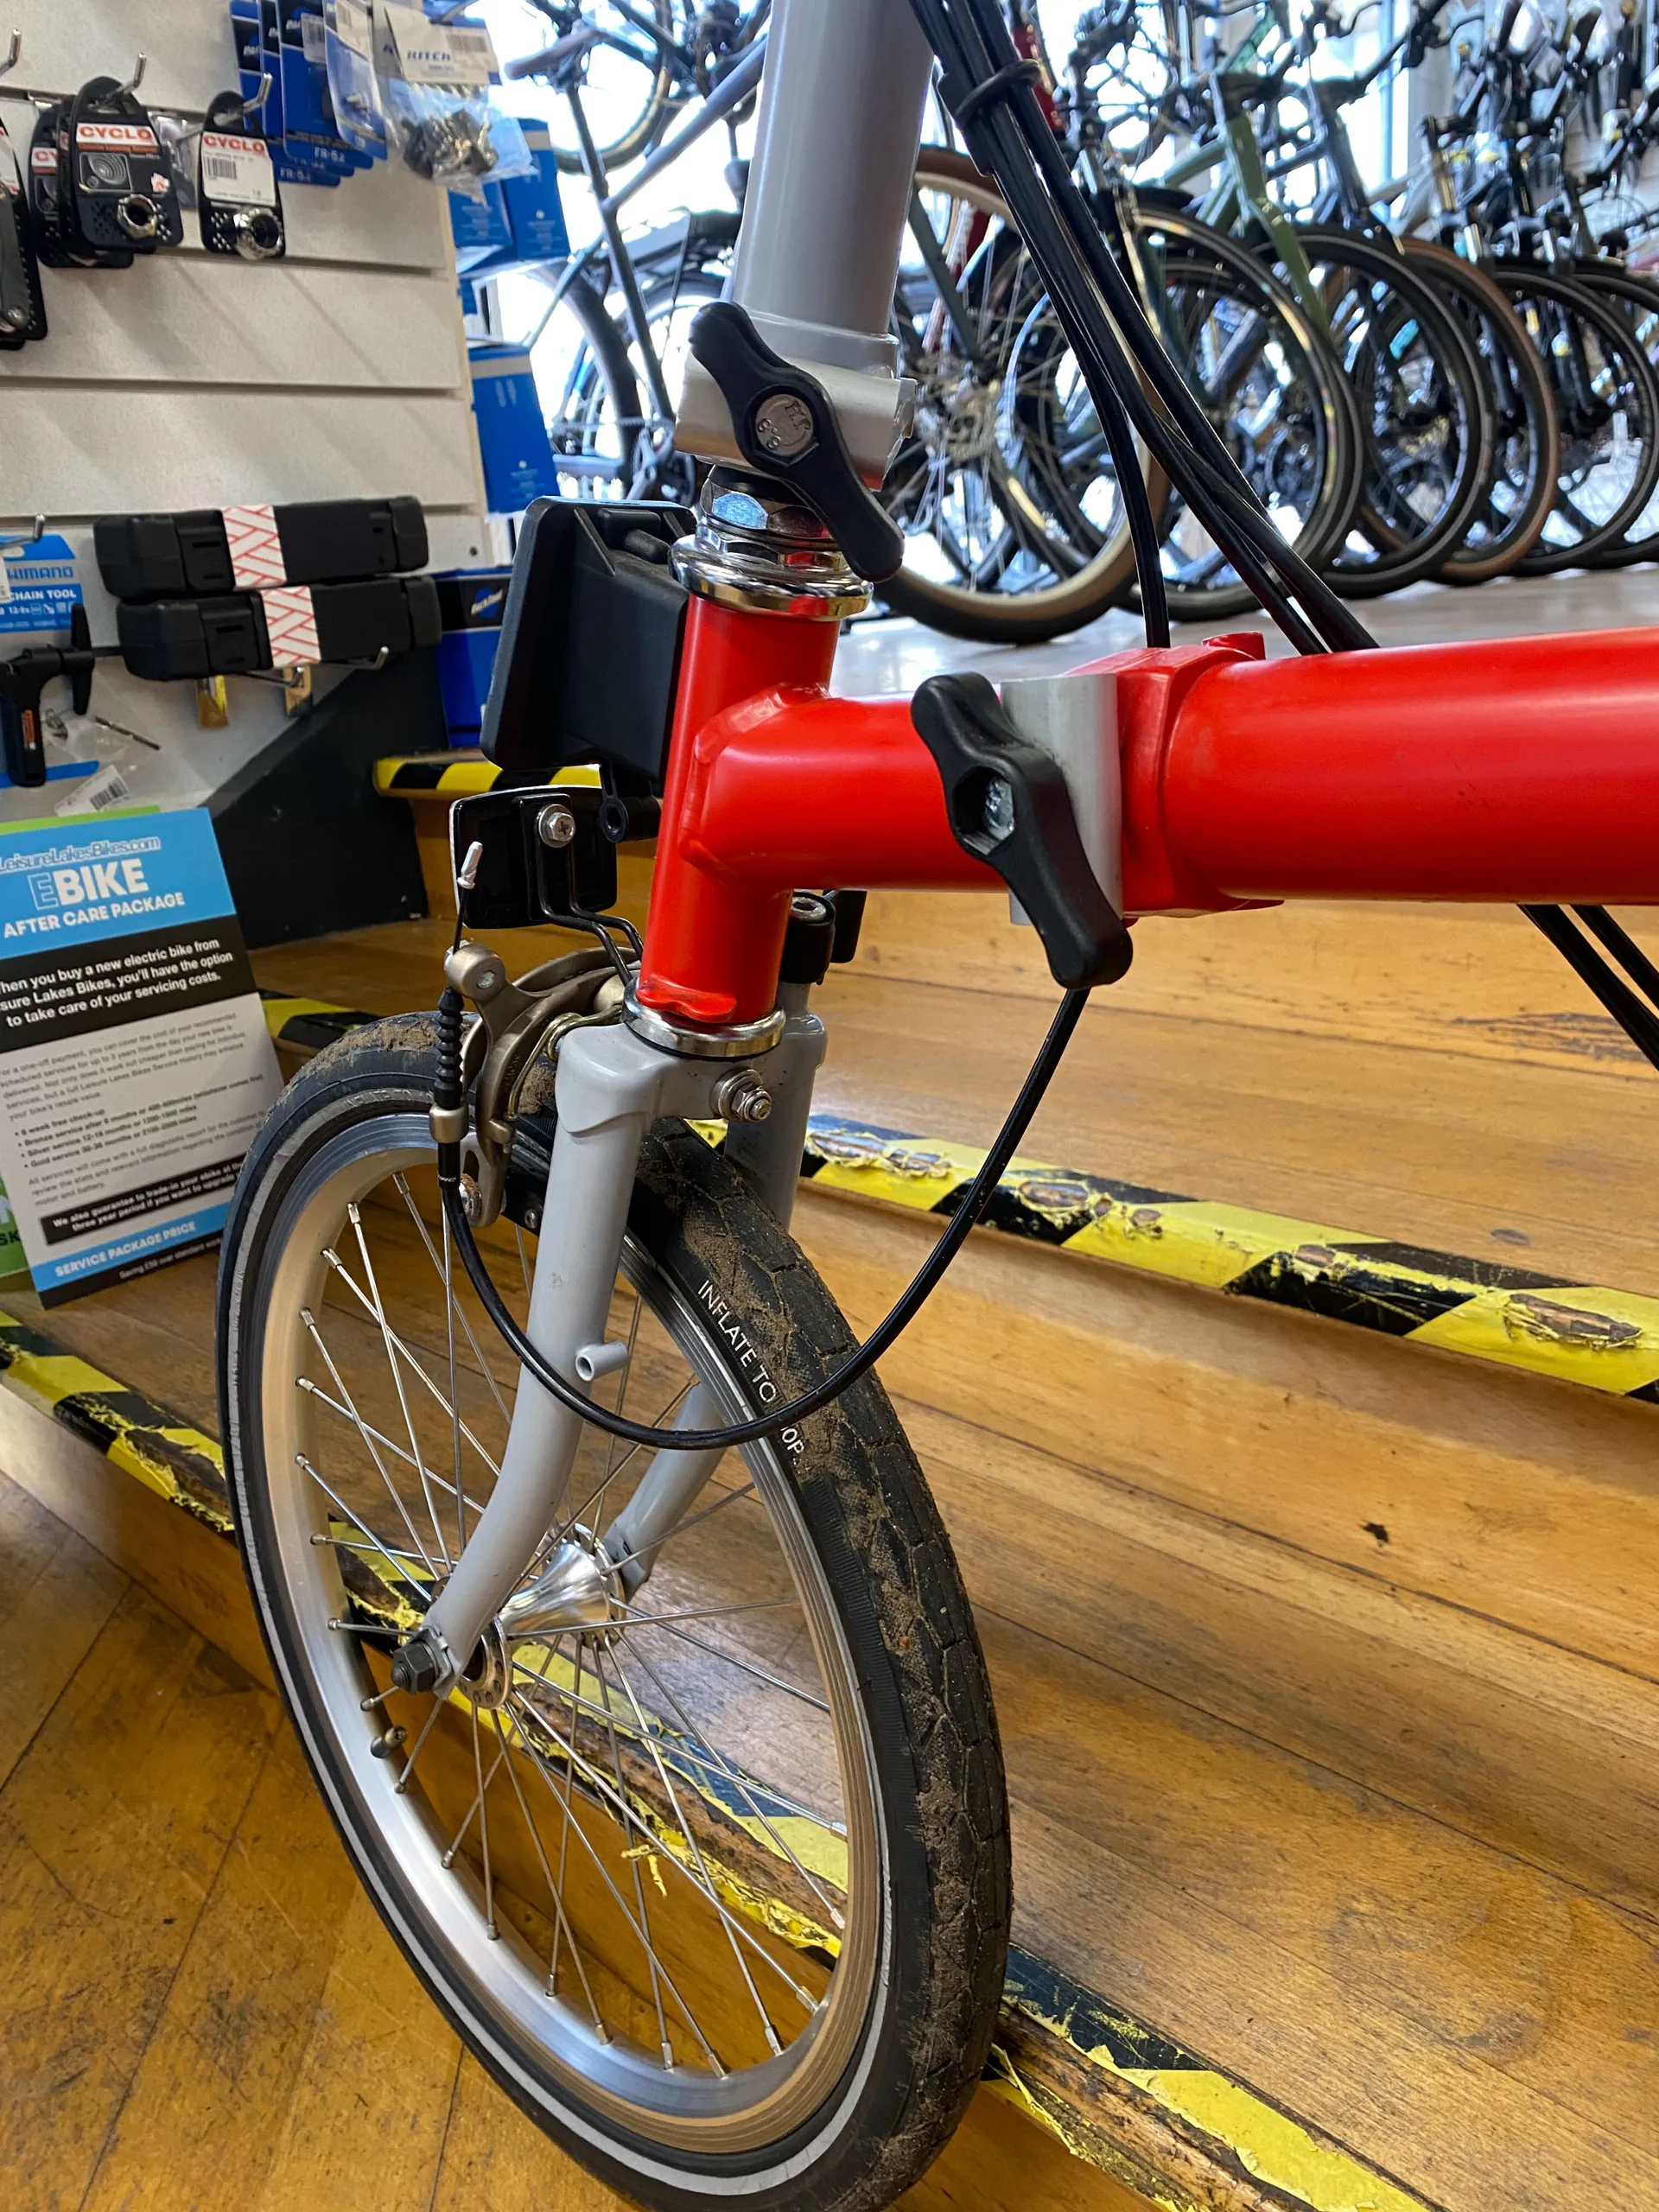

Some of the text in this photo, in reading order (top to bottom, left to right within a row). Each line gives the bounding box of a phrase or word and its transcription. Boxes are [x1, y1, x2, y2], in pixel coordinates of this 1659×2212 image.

[79, 125, 152, 141] CYCLO
[204, 135, 265, 153] CYCLO
[757, 417, 782, 450] 8.8
[8, 566, 74, 582] HIMANO
[10, 588, 77, 601] CHAIN TOOL
[0, 836, 161, 874] LeisureLakesBikes.com
[28, 858, 149, 910] EBIKE
[3, 892, 186, 938] AFTER CARE PACKAGE
[0, 938, 219, 994] hen you buy a new electric bike from
[33, 985, 73, 1002] Lakes
[76, 976, 115, 994] Bikes,
[117, 968, 149, 987] you'll
[150, 963, 178, 977] have
[180, 958, 198, 970] the
[200, 950, 233, 969] option
[6, 969, 220, 1026] to take care of your servicing costs.
[28, 1122, 48, 1132] week
[51, 1117, 67, 1126] free
[53, 1216, 67, 1226] We
[69, 1209, 89, 1221] also
[90, 1195, 134, 1216] guarantee
[135, 1192, 144, 1200] to
[180, 1176, 199, 1187] your
[199, 1168, 220, 1180] ebike
[72, 1218, 95, 1230] three
[98, 1212, 118, 1224] year
[118, 1202, 145, 1217] period
[155, 1195, 170, 1205] you
[171, 1187, 191, 1198] want
[54, 1221, 195, 1276] SERVICE PACKAGE PRICE
[697, 1279, 757, 1368] INFLATE
[752, 1364, 777, 1404] TO
